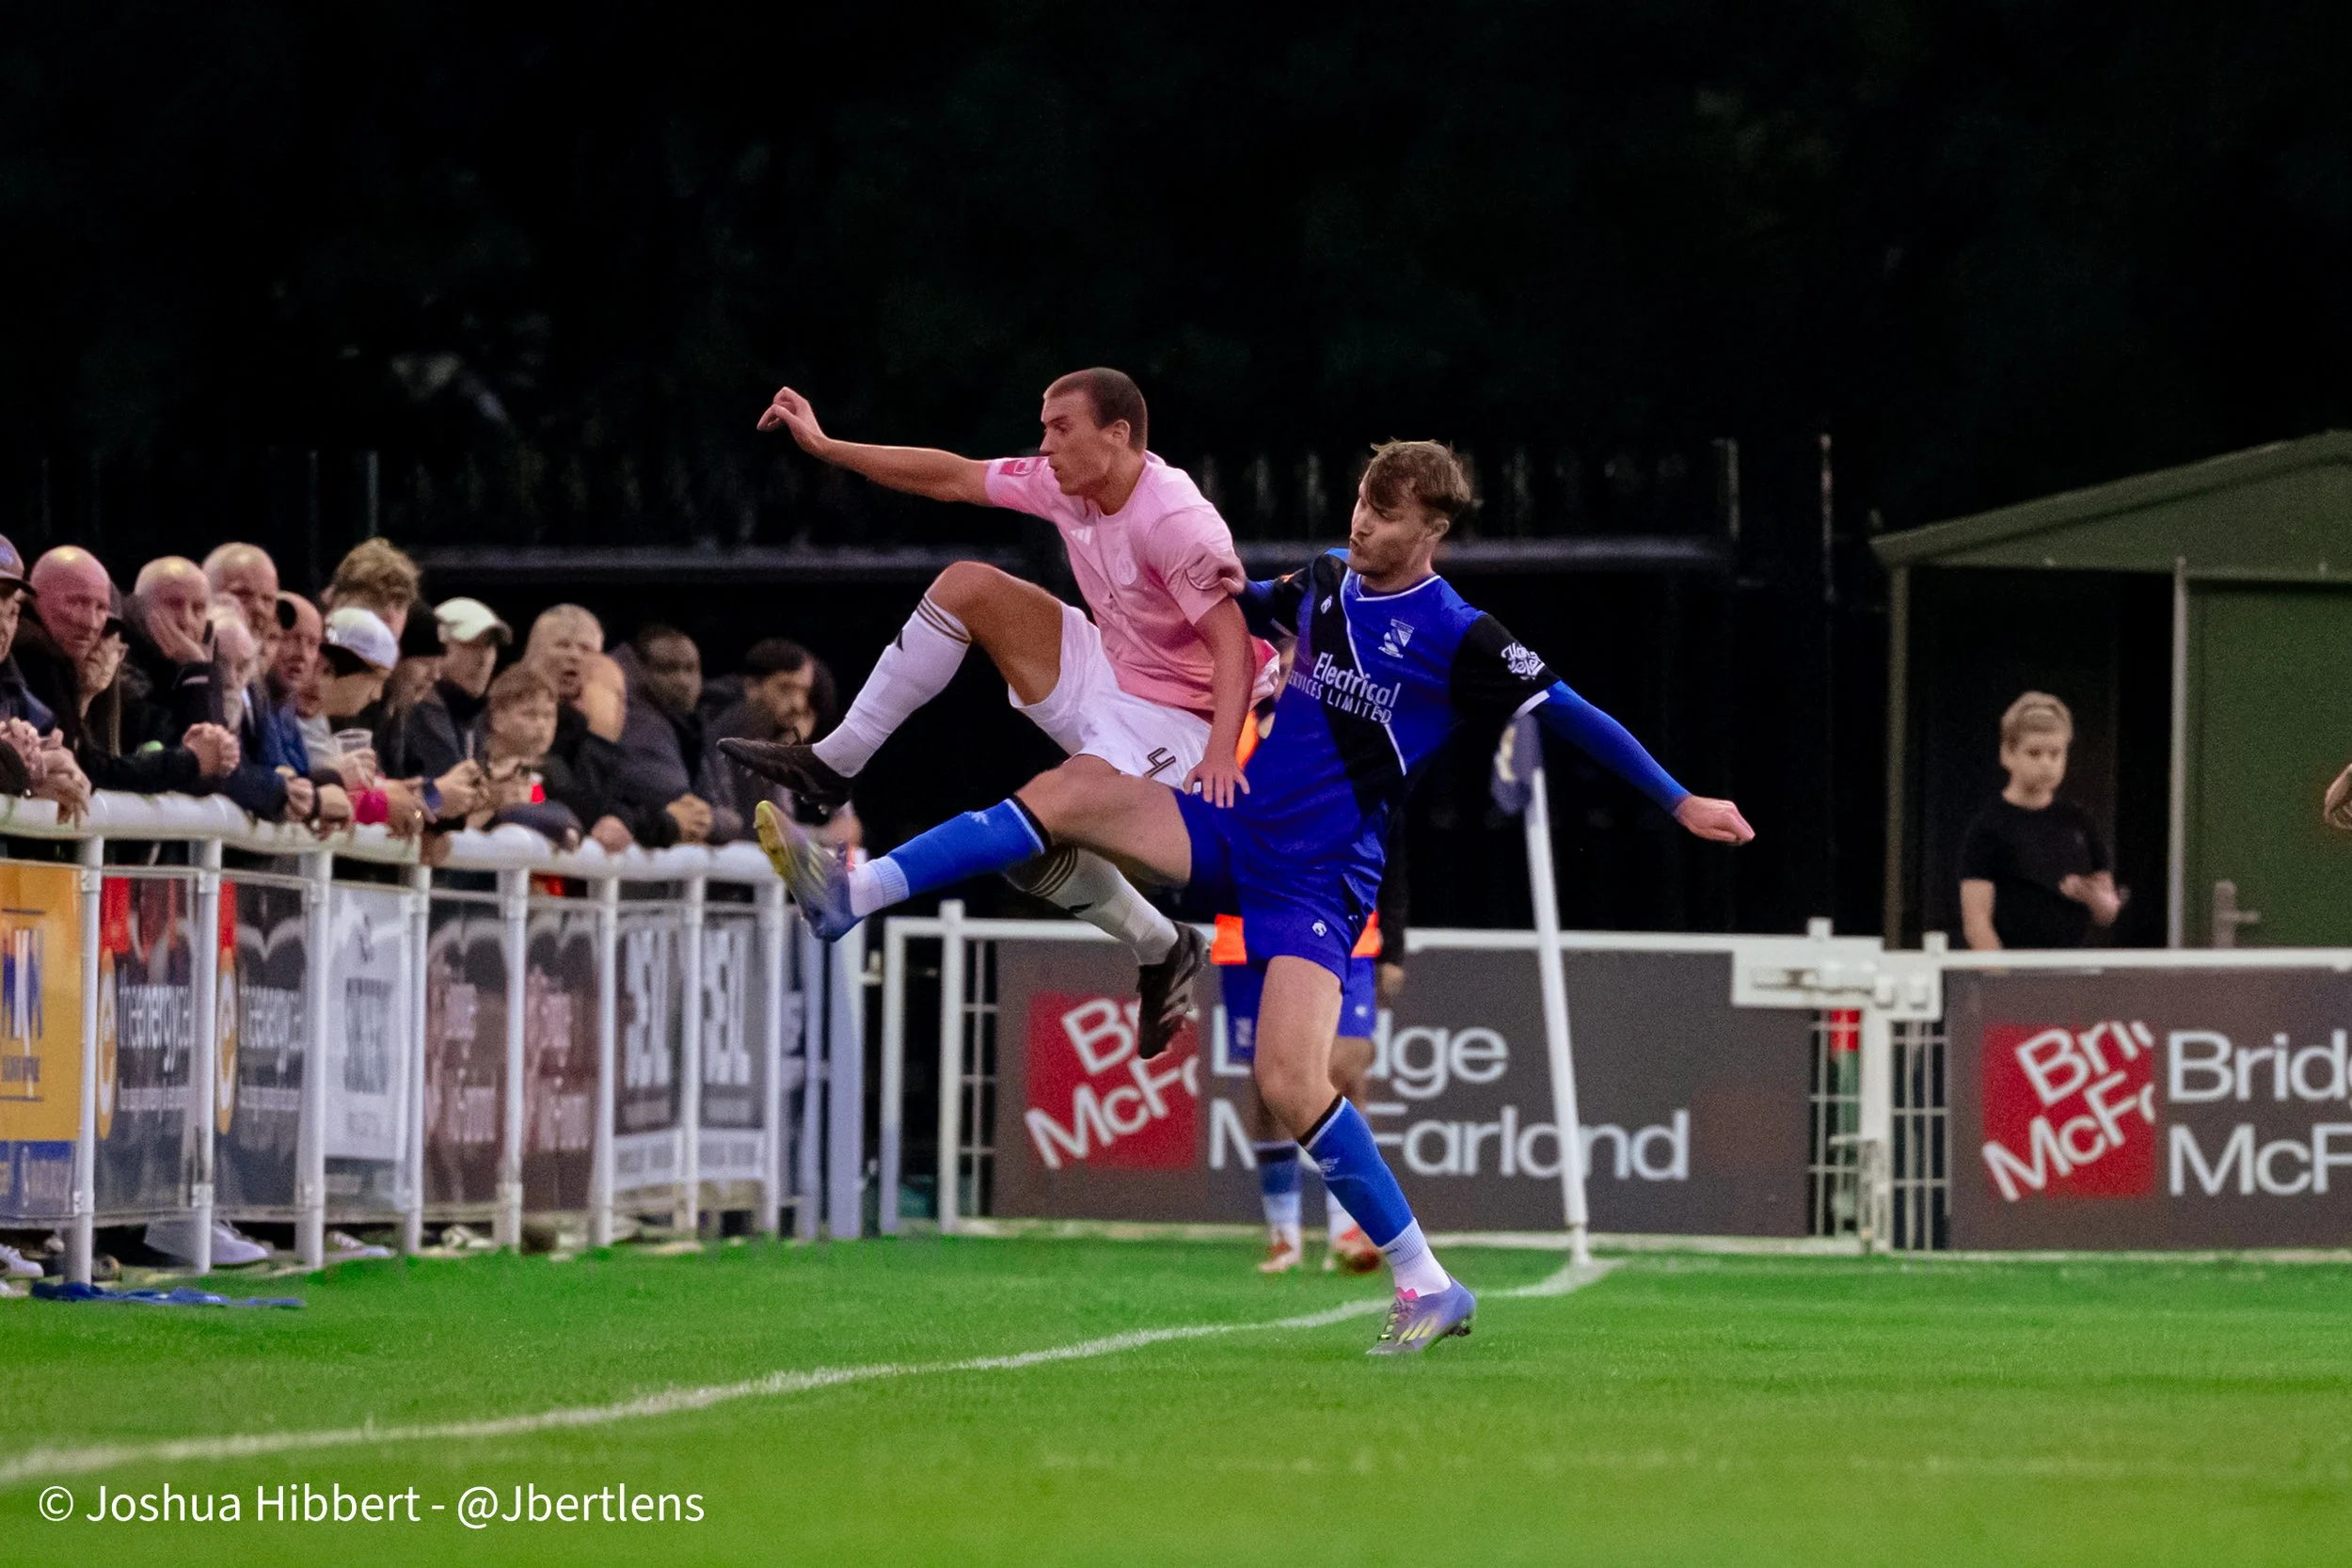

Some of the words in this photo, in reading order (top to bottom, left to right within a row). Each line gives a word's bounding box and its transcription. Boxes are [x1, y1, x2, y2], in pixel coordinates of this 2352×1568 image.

[1288, 669, 1324, 700] ERVICES
[1327, 688, 1392, 725] LIMITED
[1312, 651, 1402, 707] Electrical
[1145, 747, 1176, 779] 4
[2167, 1028, 2352, 1111] Brid
